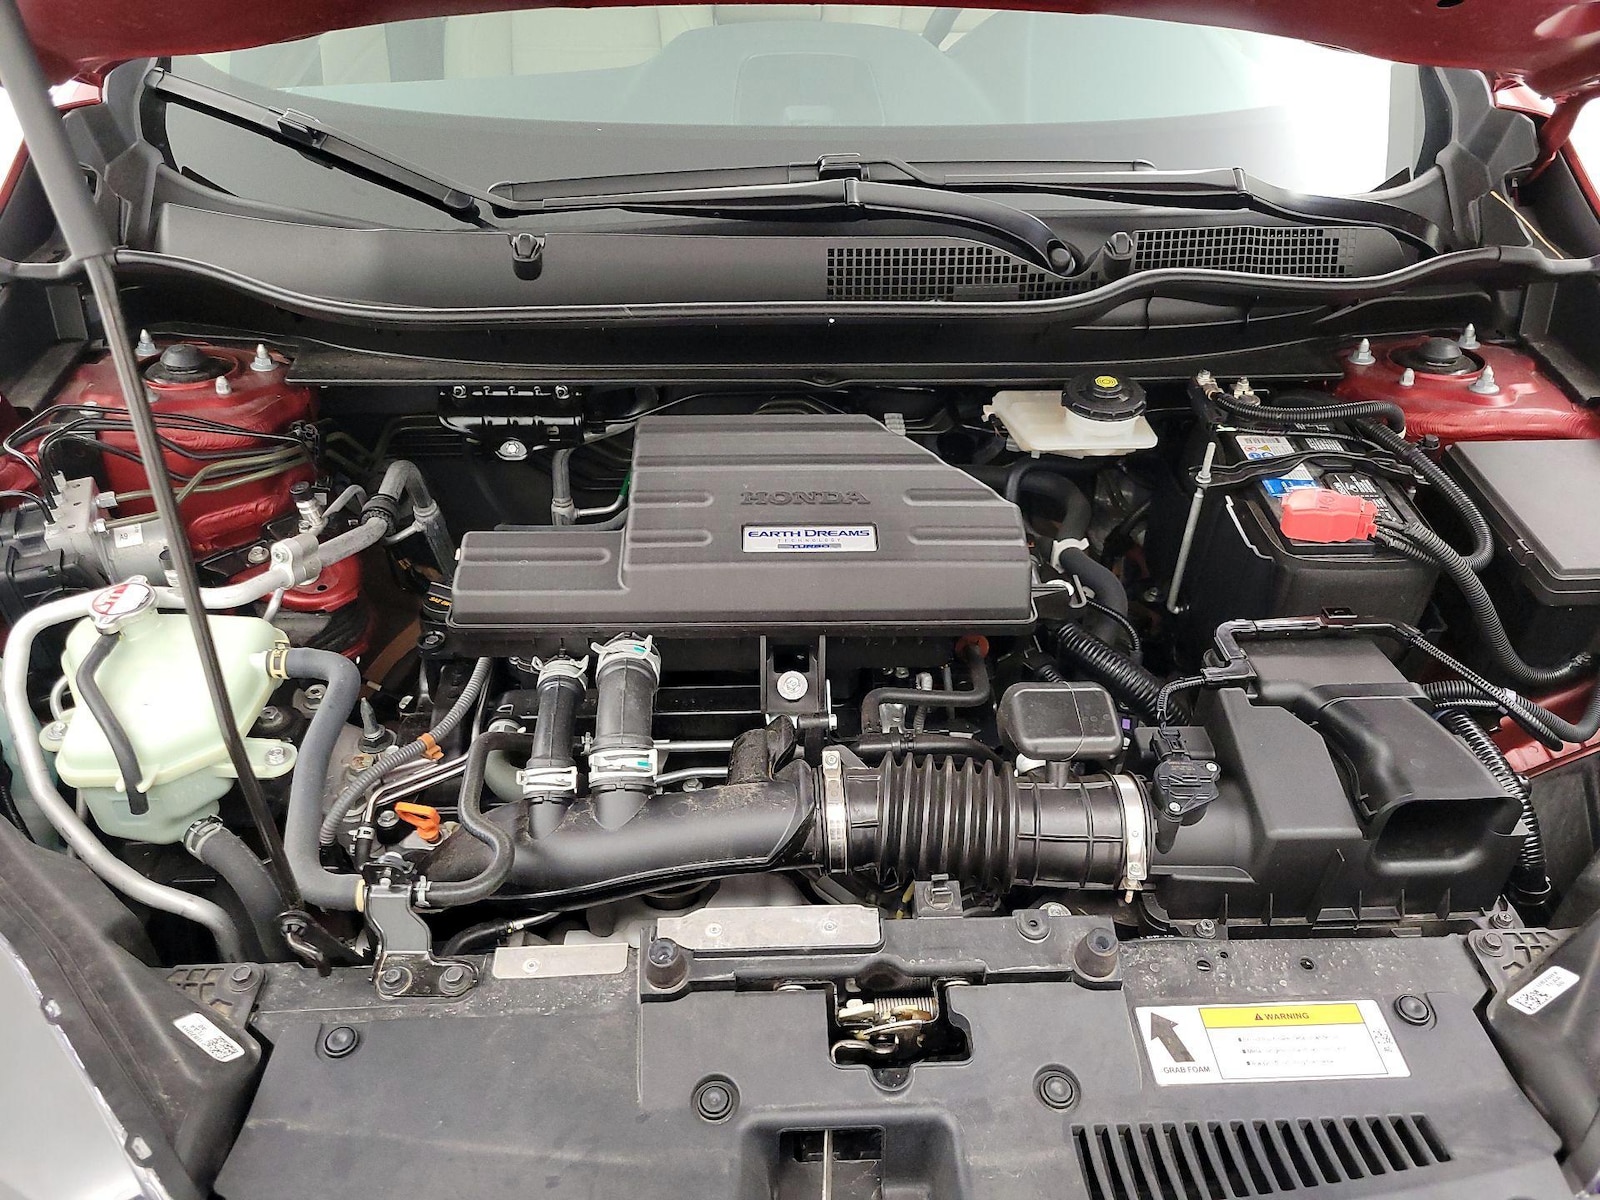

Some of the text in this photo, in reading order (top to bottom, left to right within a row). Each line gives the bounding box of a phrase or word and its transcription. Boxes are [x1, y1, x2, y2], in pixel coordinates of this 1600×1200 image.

[740, 491, 871, 505] HONDA
[748, 529, 870, 538] EARTH DREAMS
[1263, 1011, 1310, 1021] WARNING
[1163, 1065, 1211, 1074] GRAB FOAM
